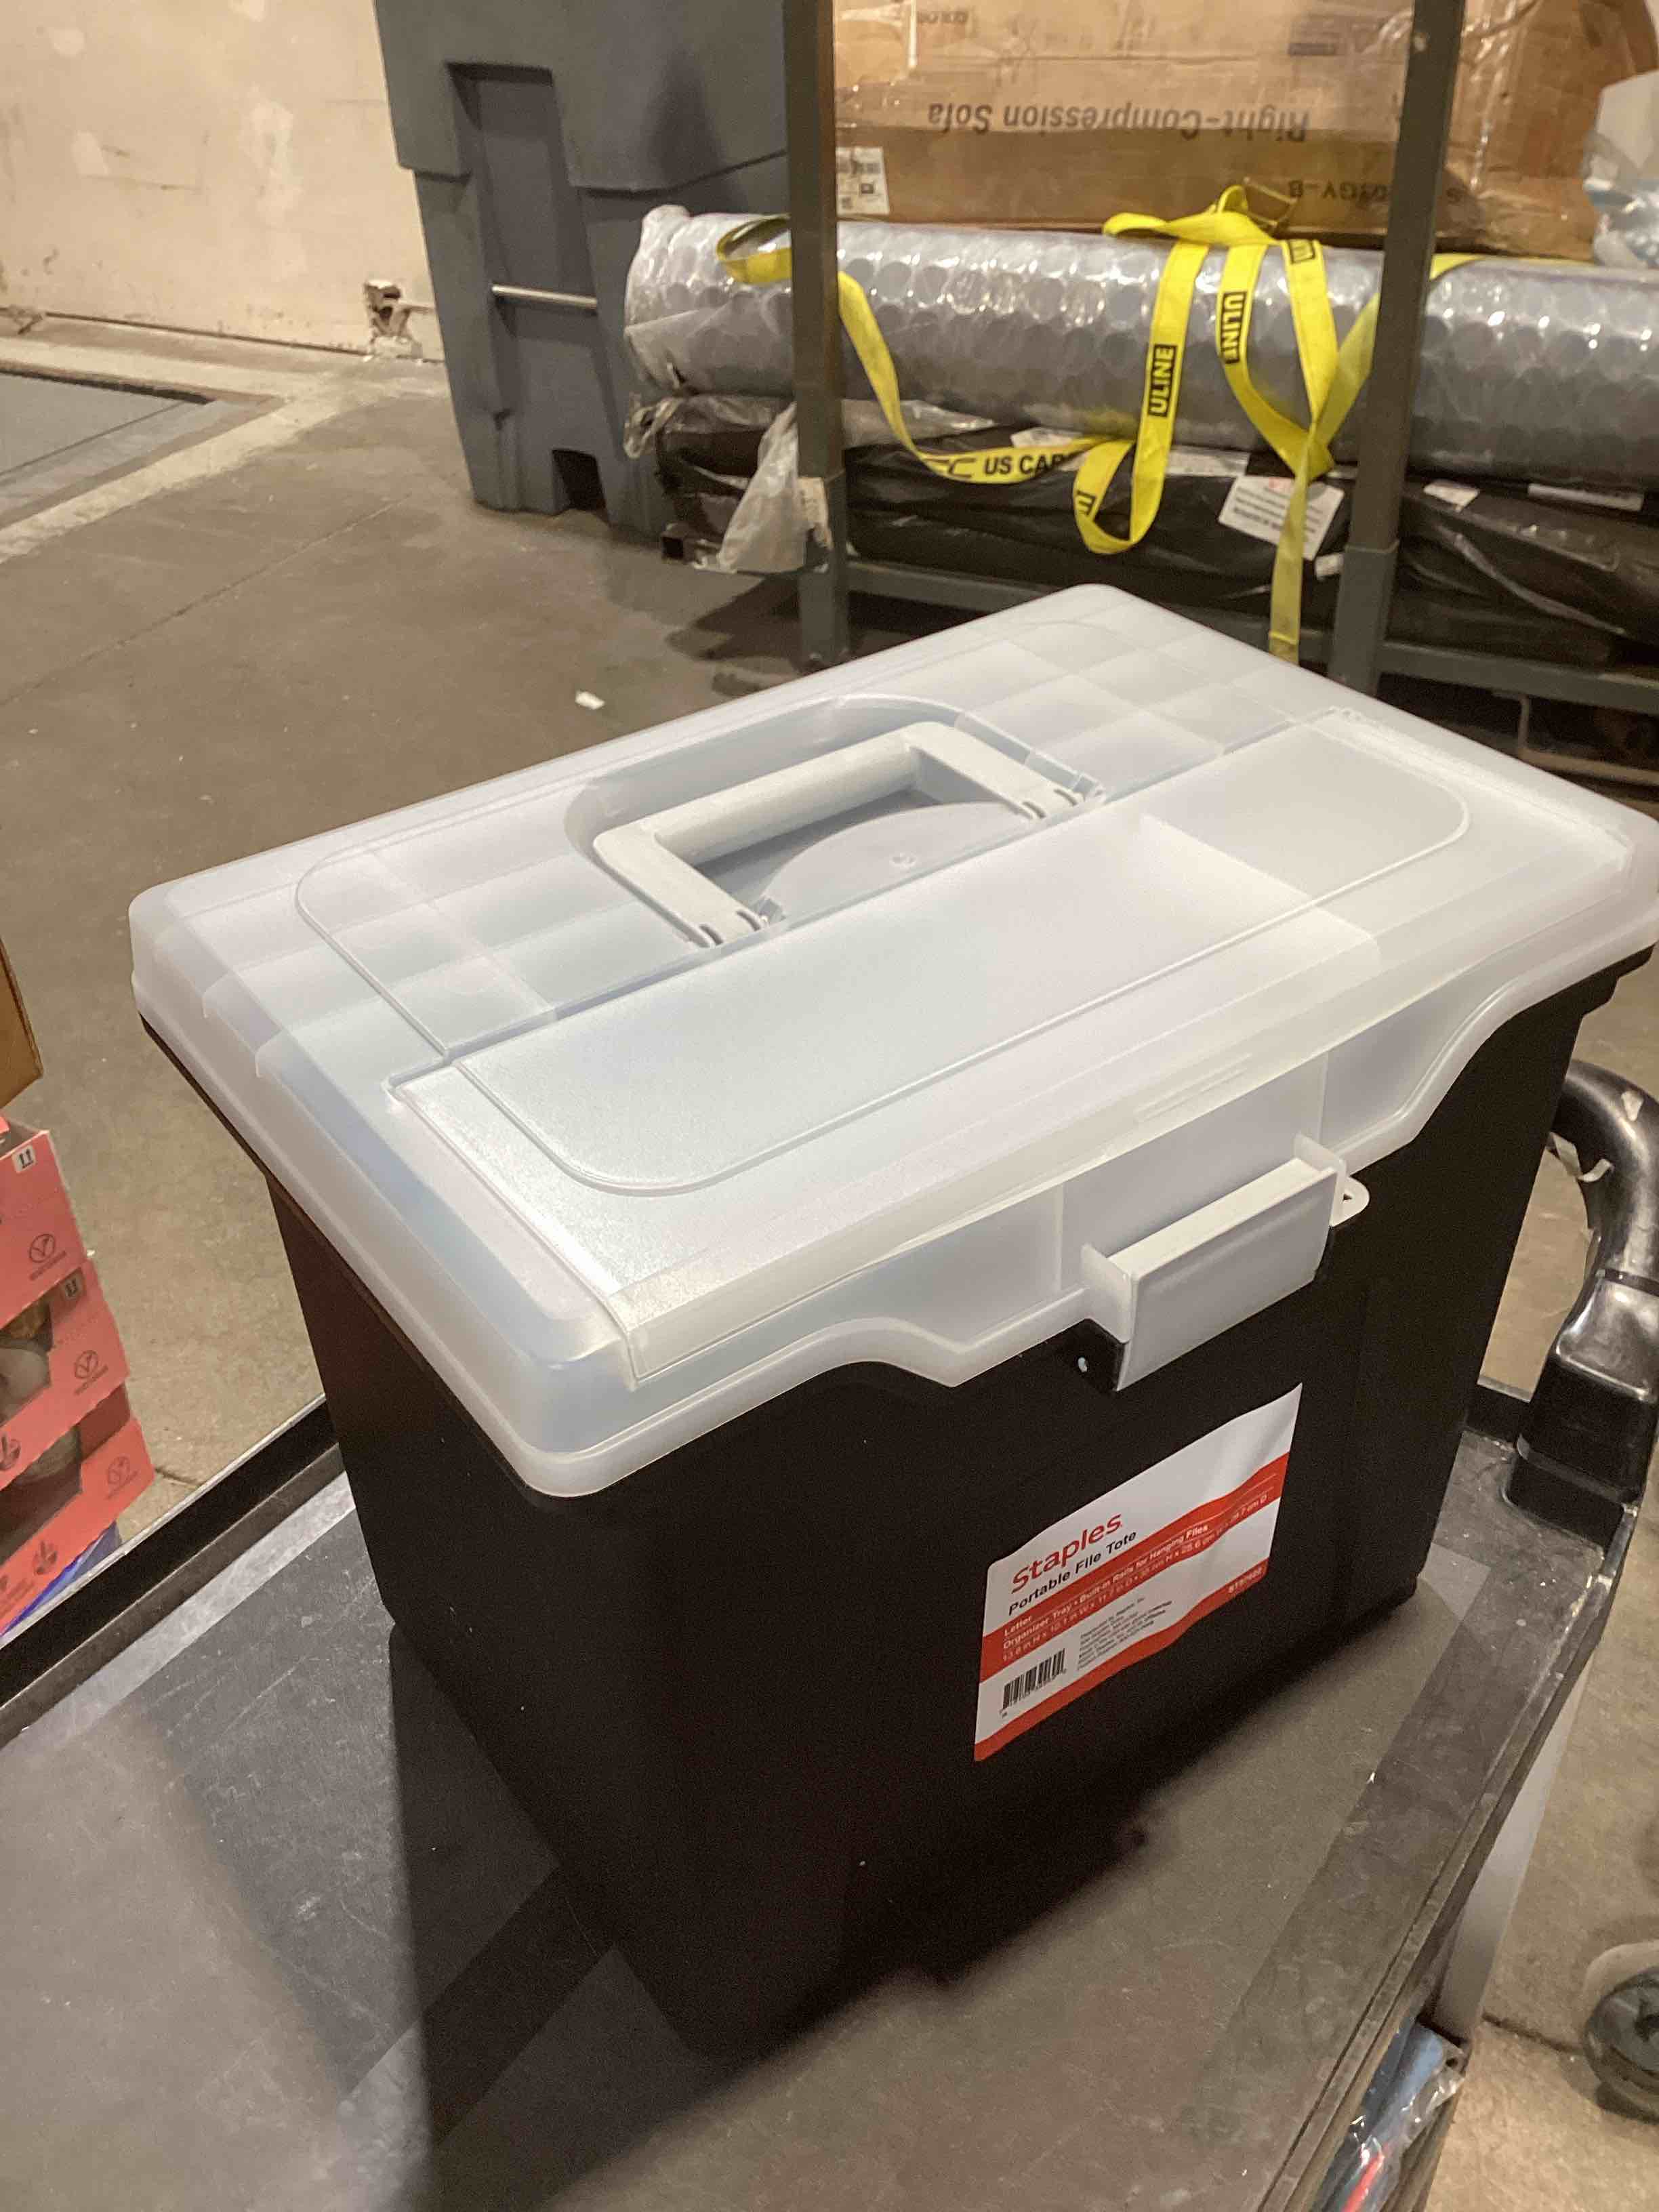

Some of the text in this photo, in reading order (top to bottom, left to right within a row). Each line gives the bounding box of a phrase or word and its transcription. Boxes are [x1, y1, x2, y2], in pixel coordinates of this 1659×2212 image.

[927, 100, 1311, 142] Right-Compression Sofa
[1221, 293, 1246, 363] ULINE
[1149, 346, 1175, 416] ULINE
[984, 450, 1073, 476] US CAR
[1185, 1524, 1209, 1540] Files
[1008, 1531, 1136, 1616] Portable File Tote
[1004, 1615, 1032, 1637] Letter
